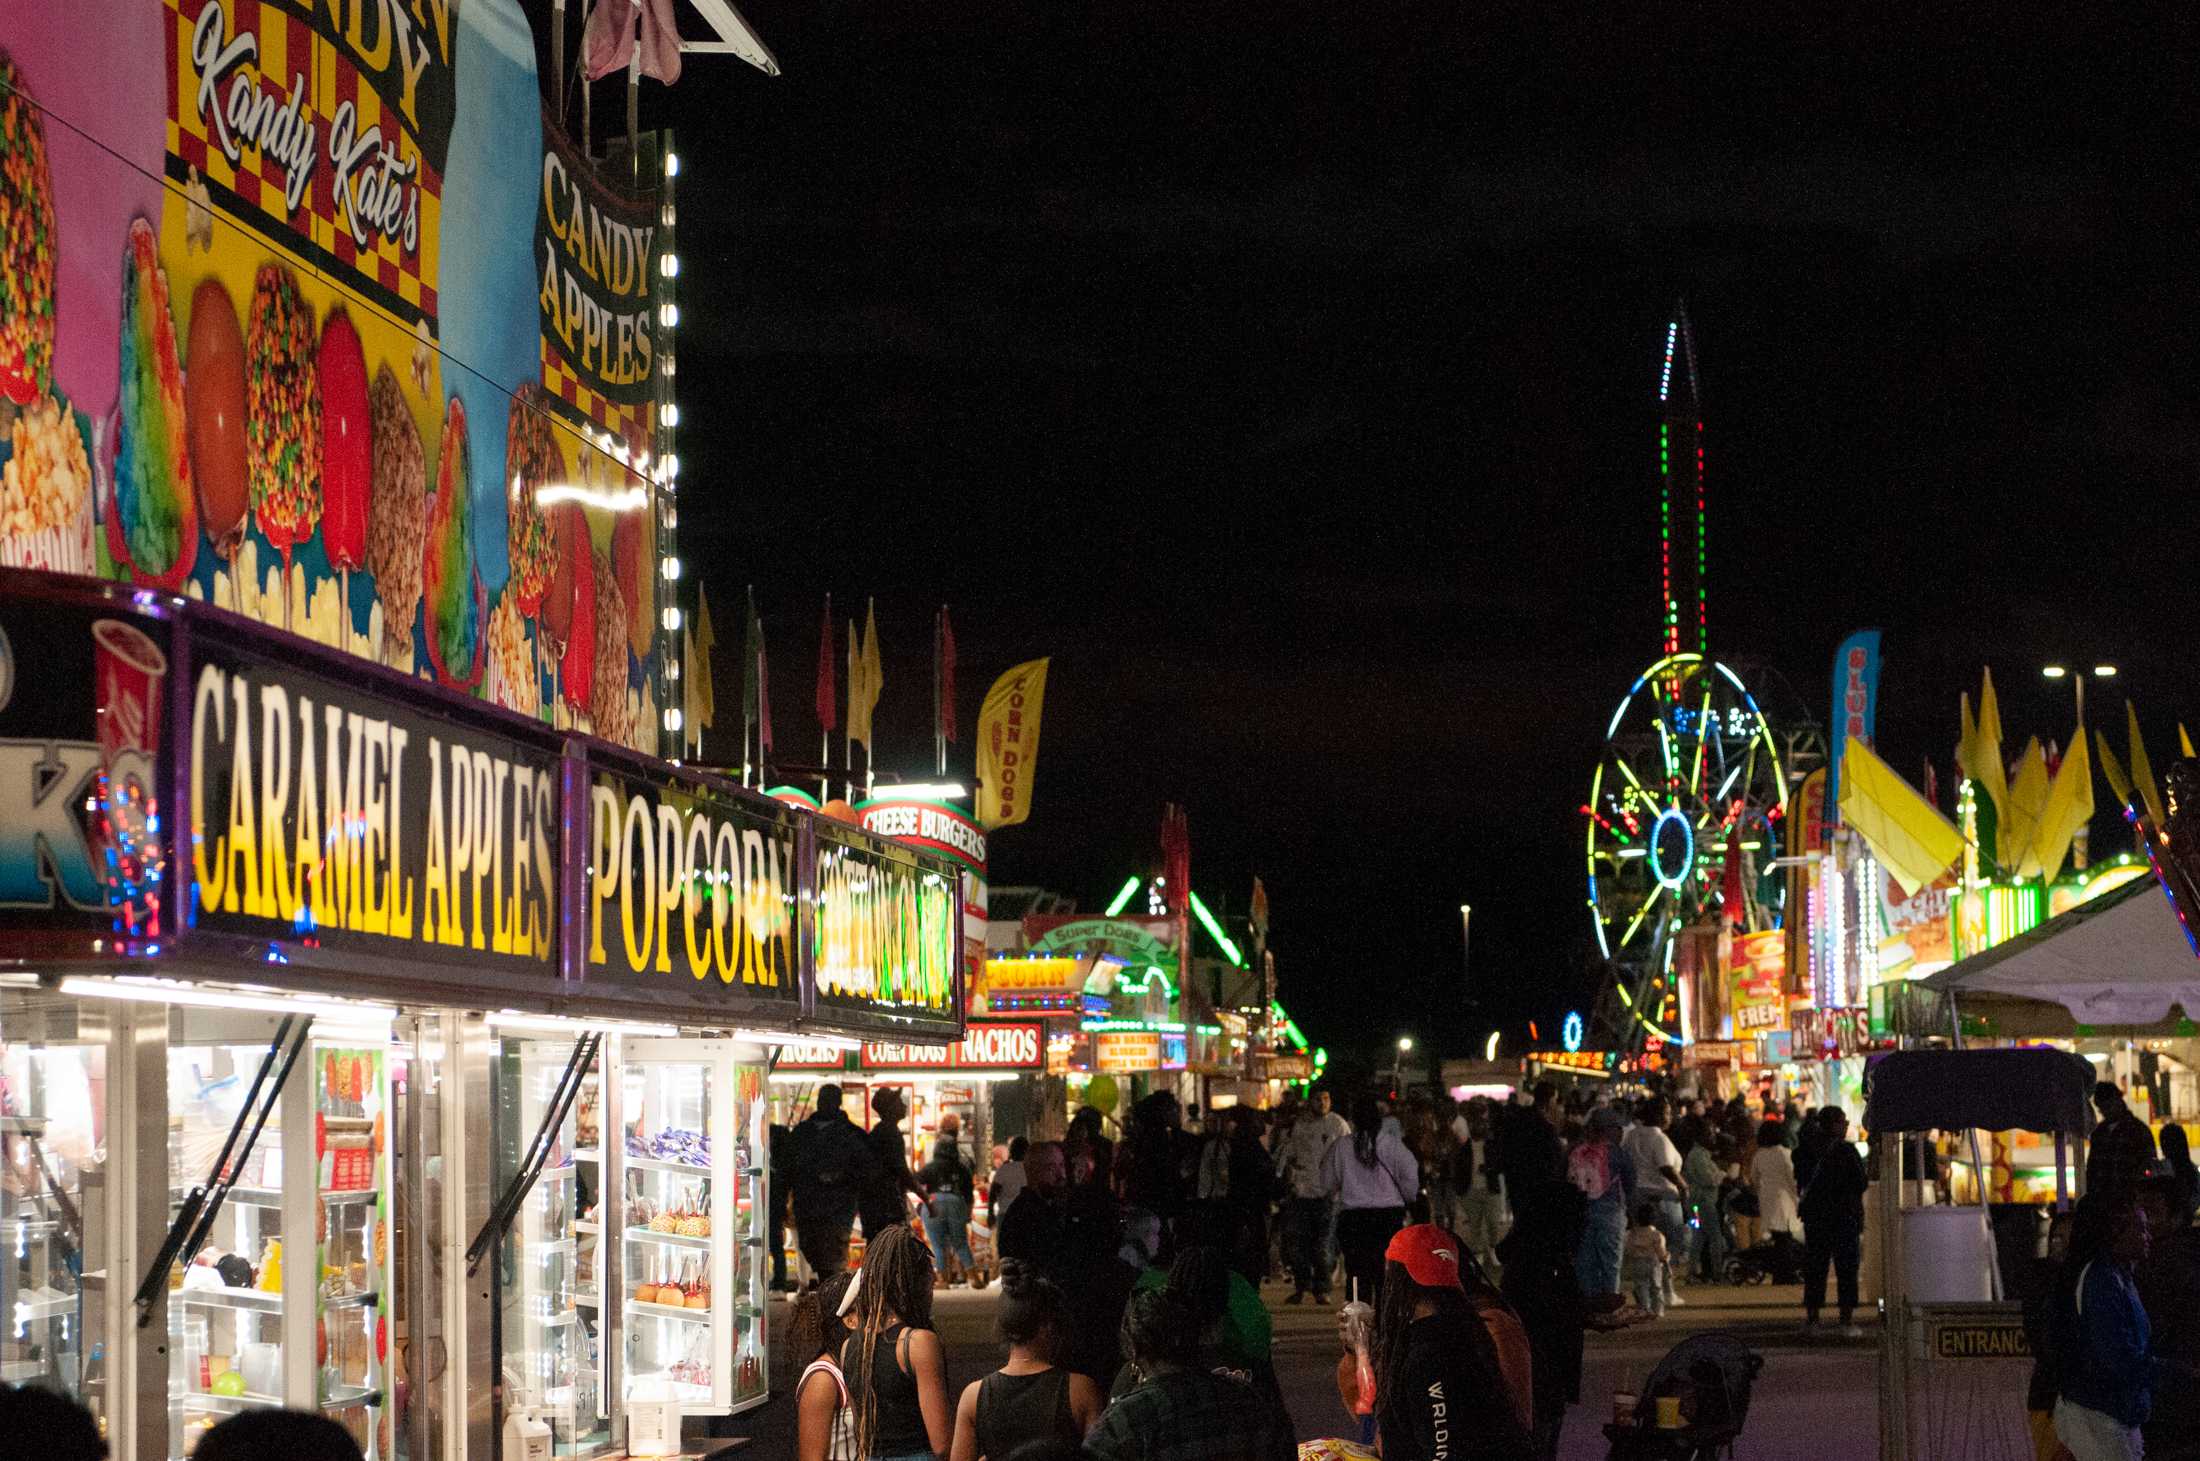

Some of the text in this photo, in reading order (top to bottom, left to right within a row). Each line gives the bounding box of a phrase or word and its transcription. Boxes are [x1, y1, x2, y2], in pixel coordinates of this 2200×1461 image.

[192, 0, 417, 252] Kandy Kate's
[543, 150, 654, 299] CANDY
[540, 235, 653, 386] APPLES
[1845, 646, 1868, 741] SLUS
[192, 663, 555, 963] CARAMEL APPLES
[589, 785, 794, 990] POPCORN
[863, 806, 987, 863] CHEESE BURGERS
[960, 1028, 1037, 1063] NACHOS
[1942, 1328, 2031, 1355] ENTRANC
